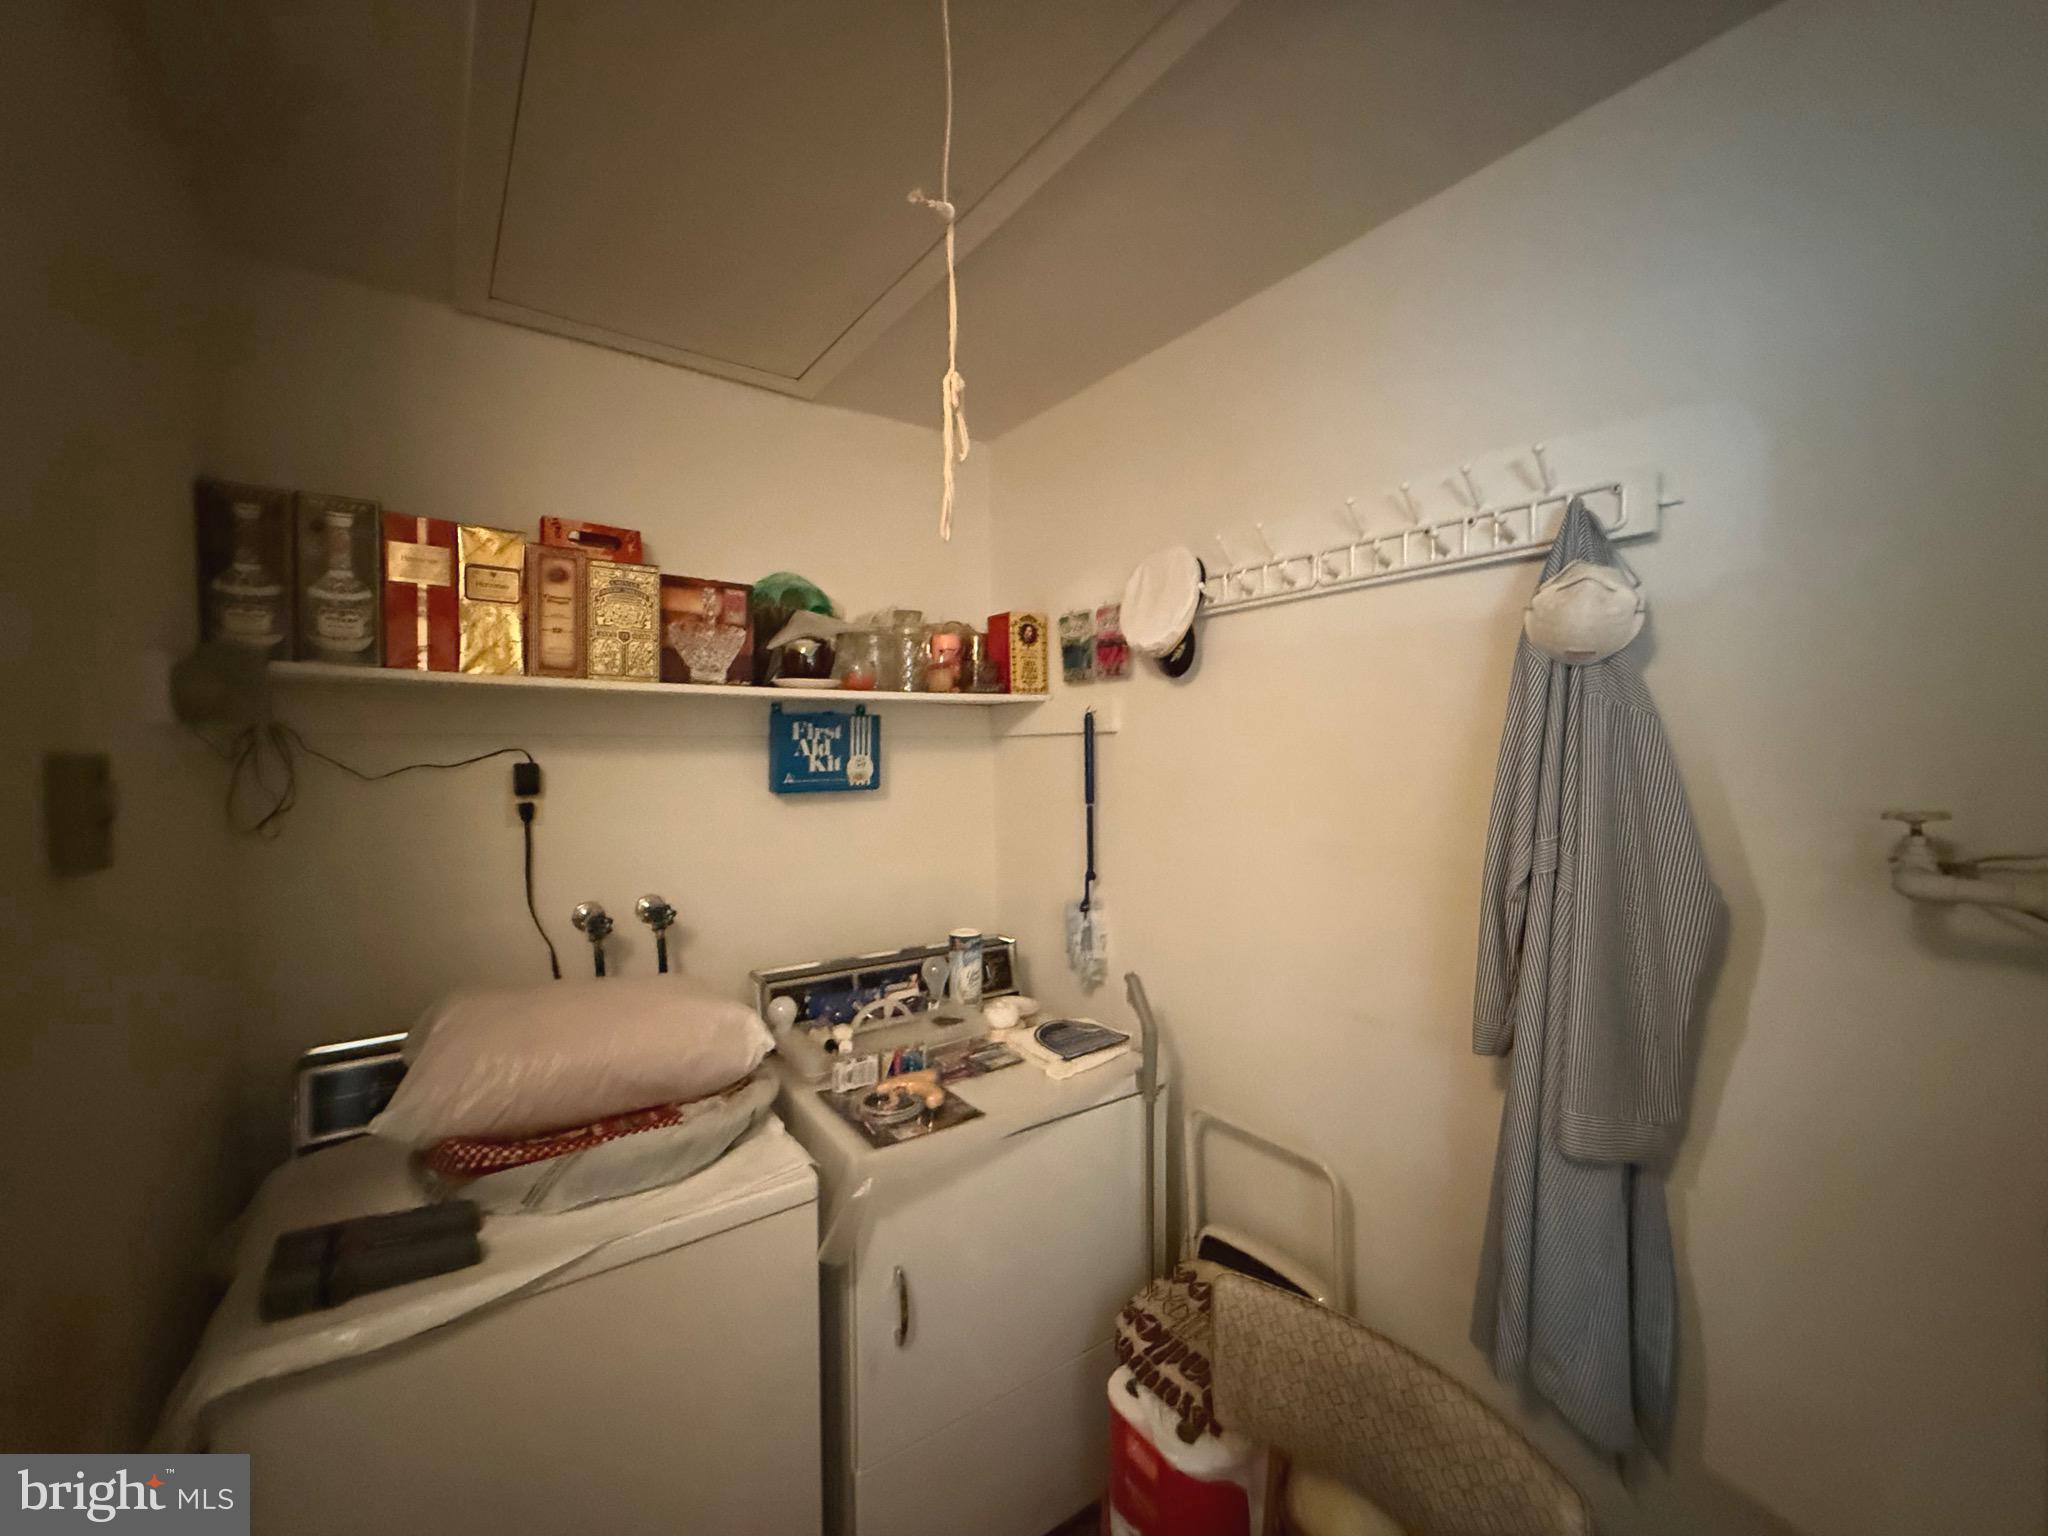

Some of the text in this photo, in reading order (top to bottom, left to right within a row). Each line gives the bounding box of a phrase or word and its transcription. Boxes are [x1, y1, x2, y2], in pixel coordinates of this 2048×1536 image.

[792, 721, 841, 741] First
[793, 738, 831, 757] Aid
[809, 754, 841, 773] Kit
